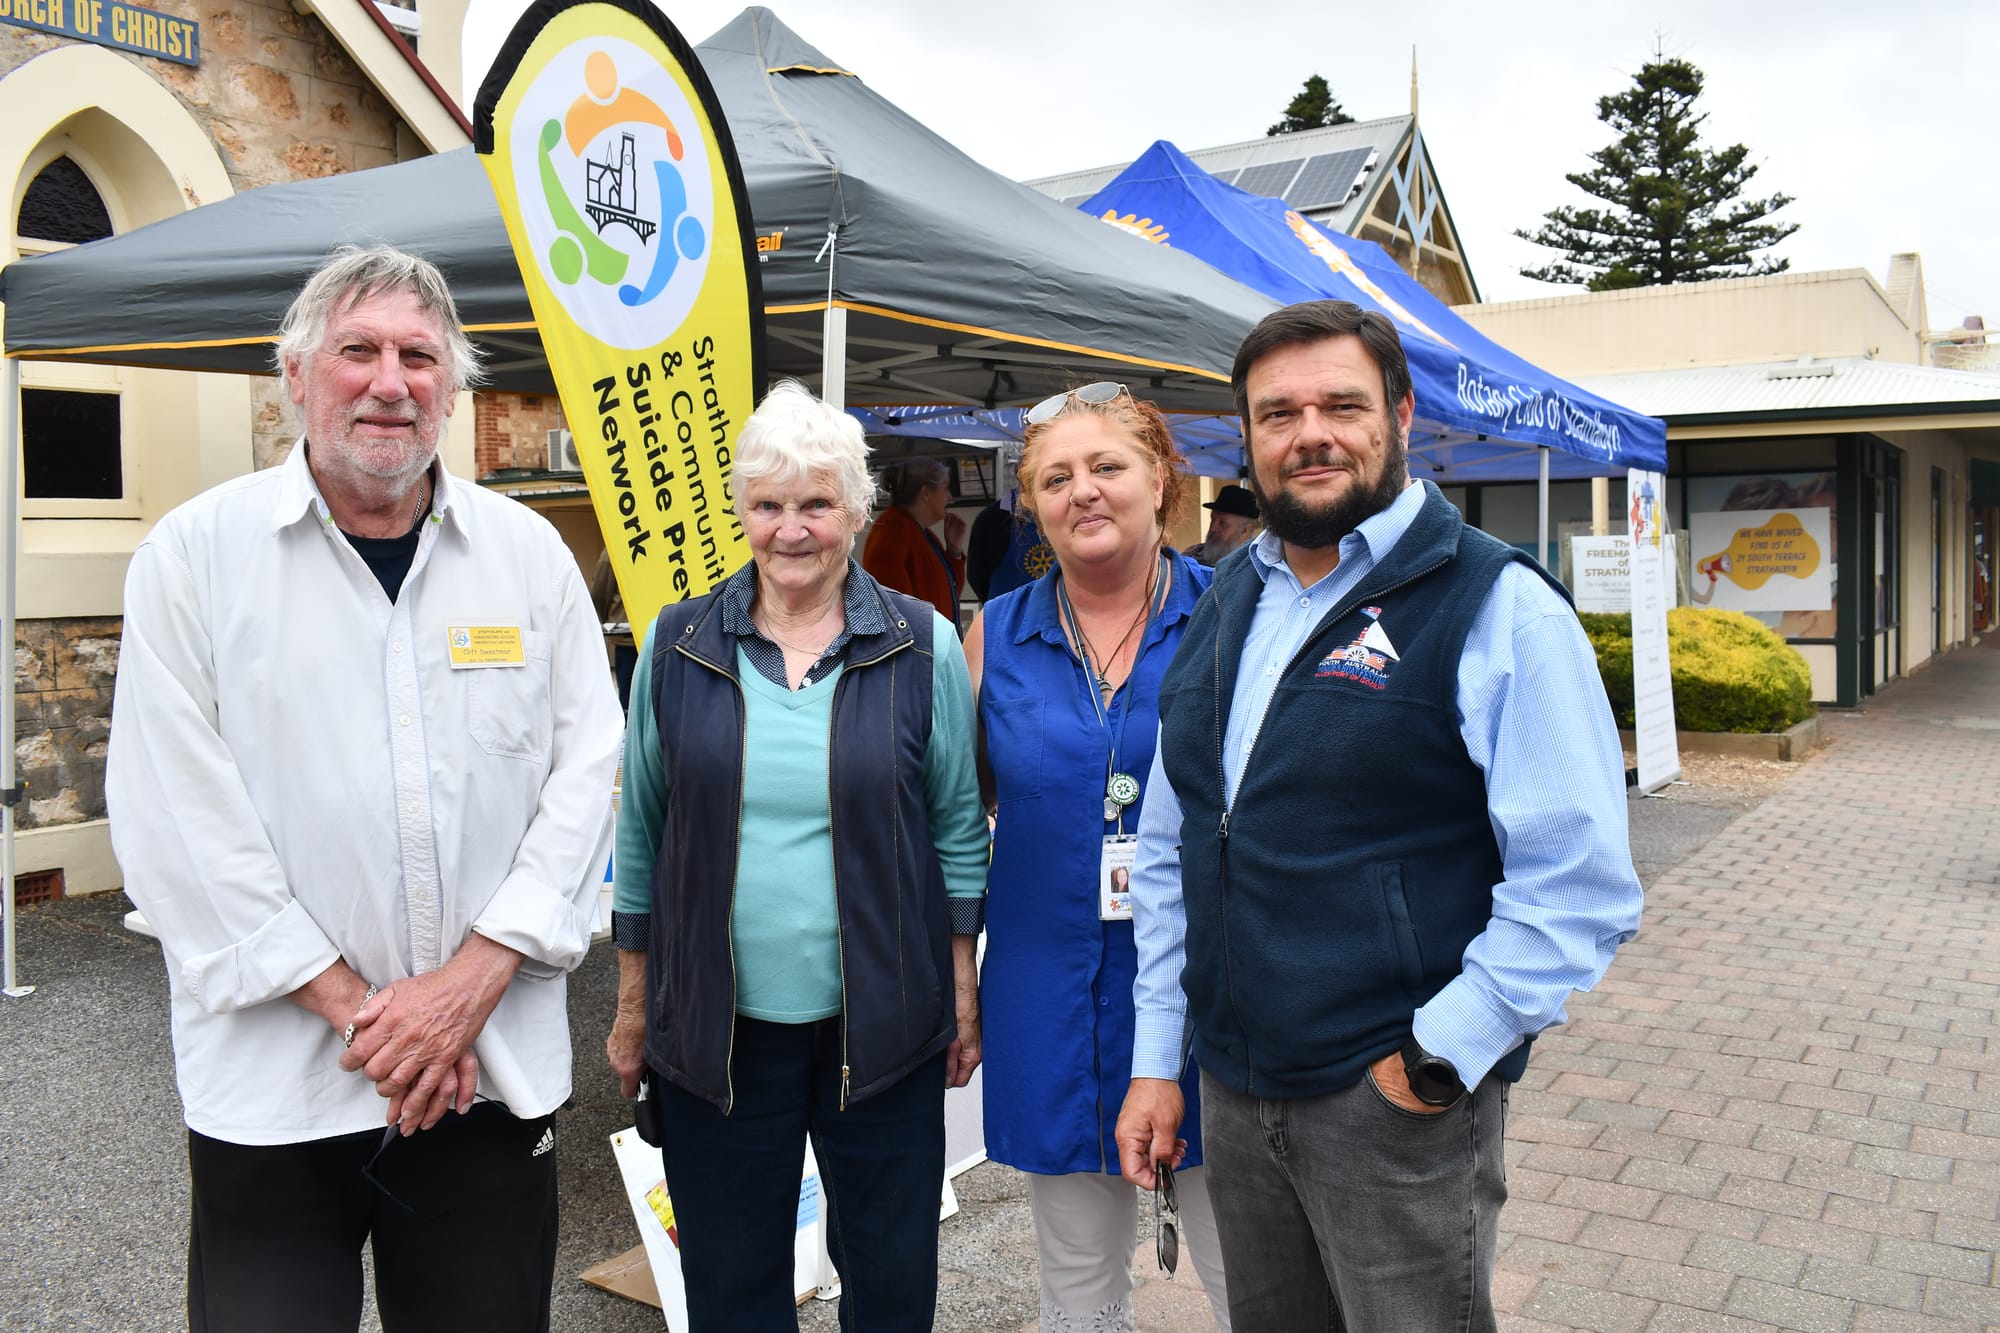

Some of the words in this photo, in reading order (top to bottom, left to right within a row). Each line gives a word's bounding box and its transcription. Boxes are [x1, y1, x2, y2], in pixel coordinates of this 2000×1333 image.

[75, 0, 103, 37] OF
[112, 6, 194, 60] CHRIST
[661, 351, 683, 380] &
[627, 362, 674, 512] Suicide
[1547, 389, 1561, 432] of
[593, 376, 651, 565] Network
